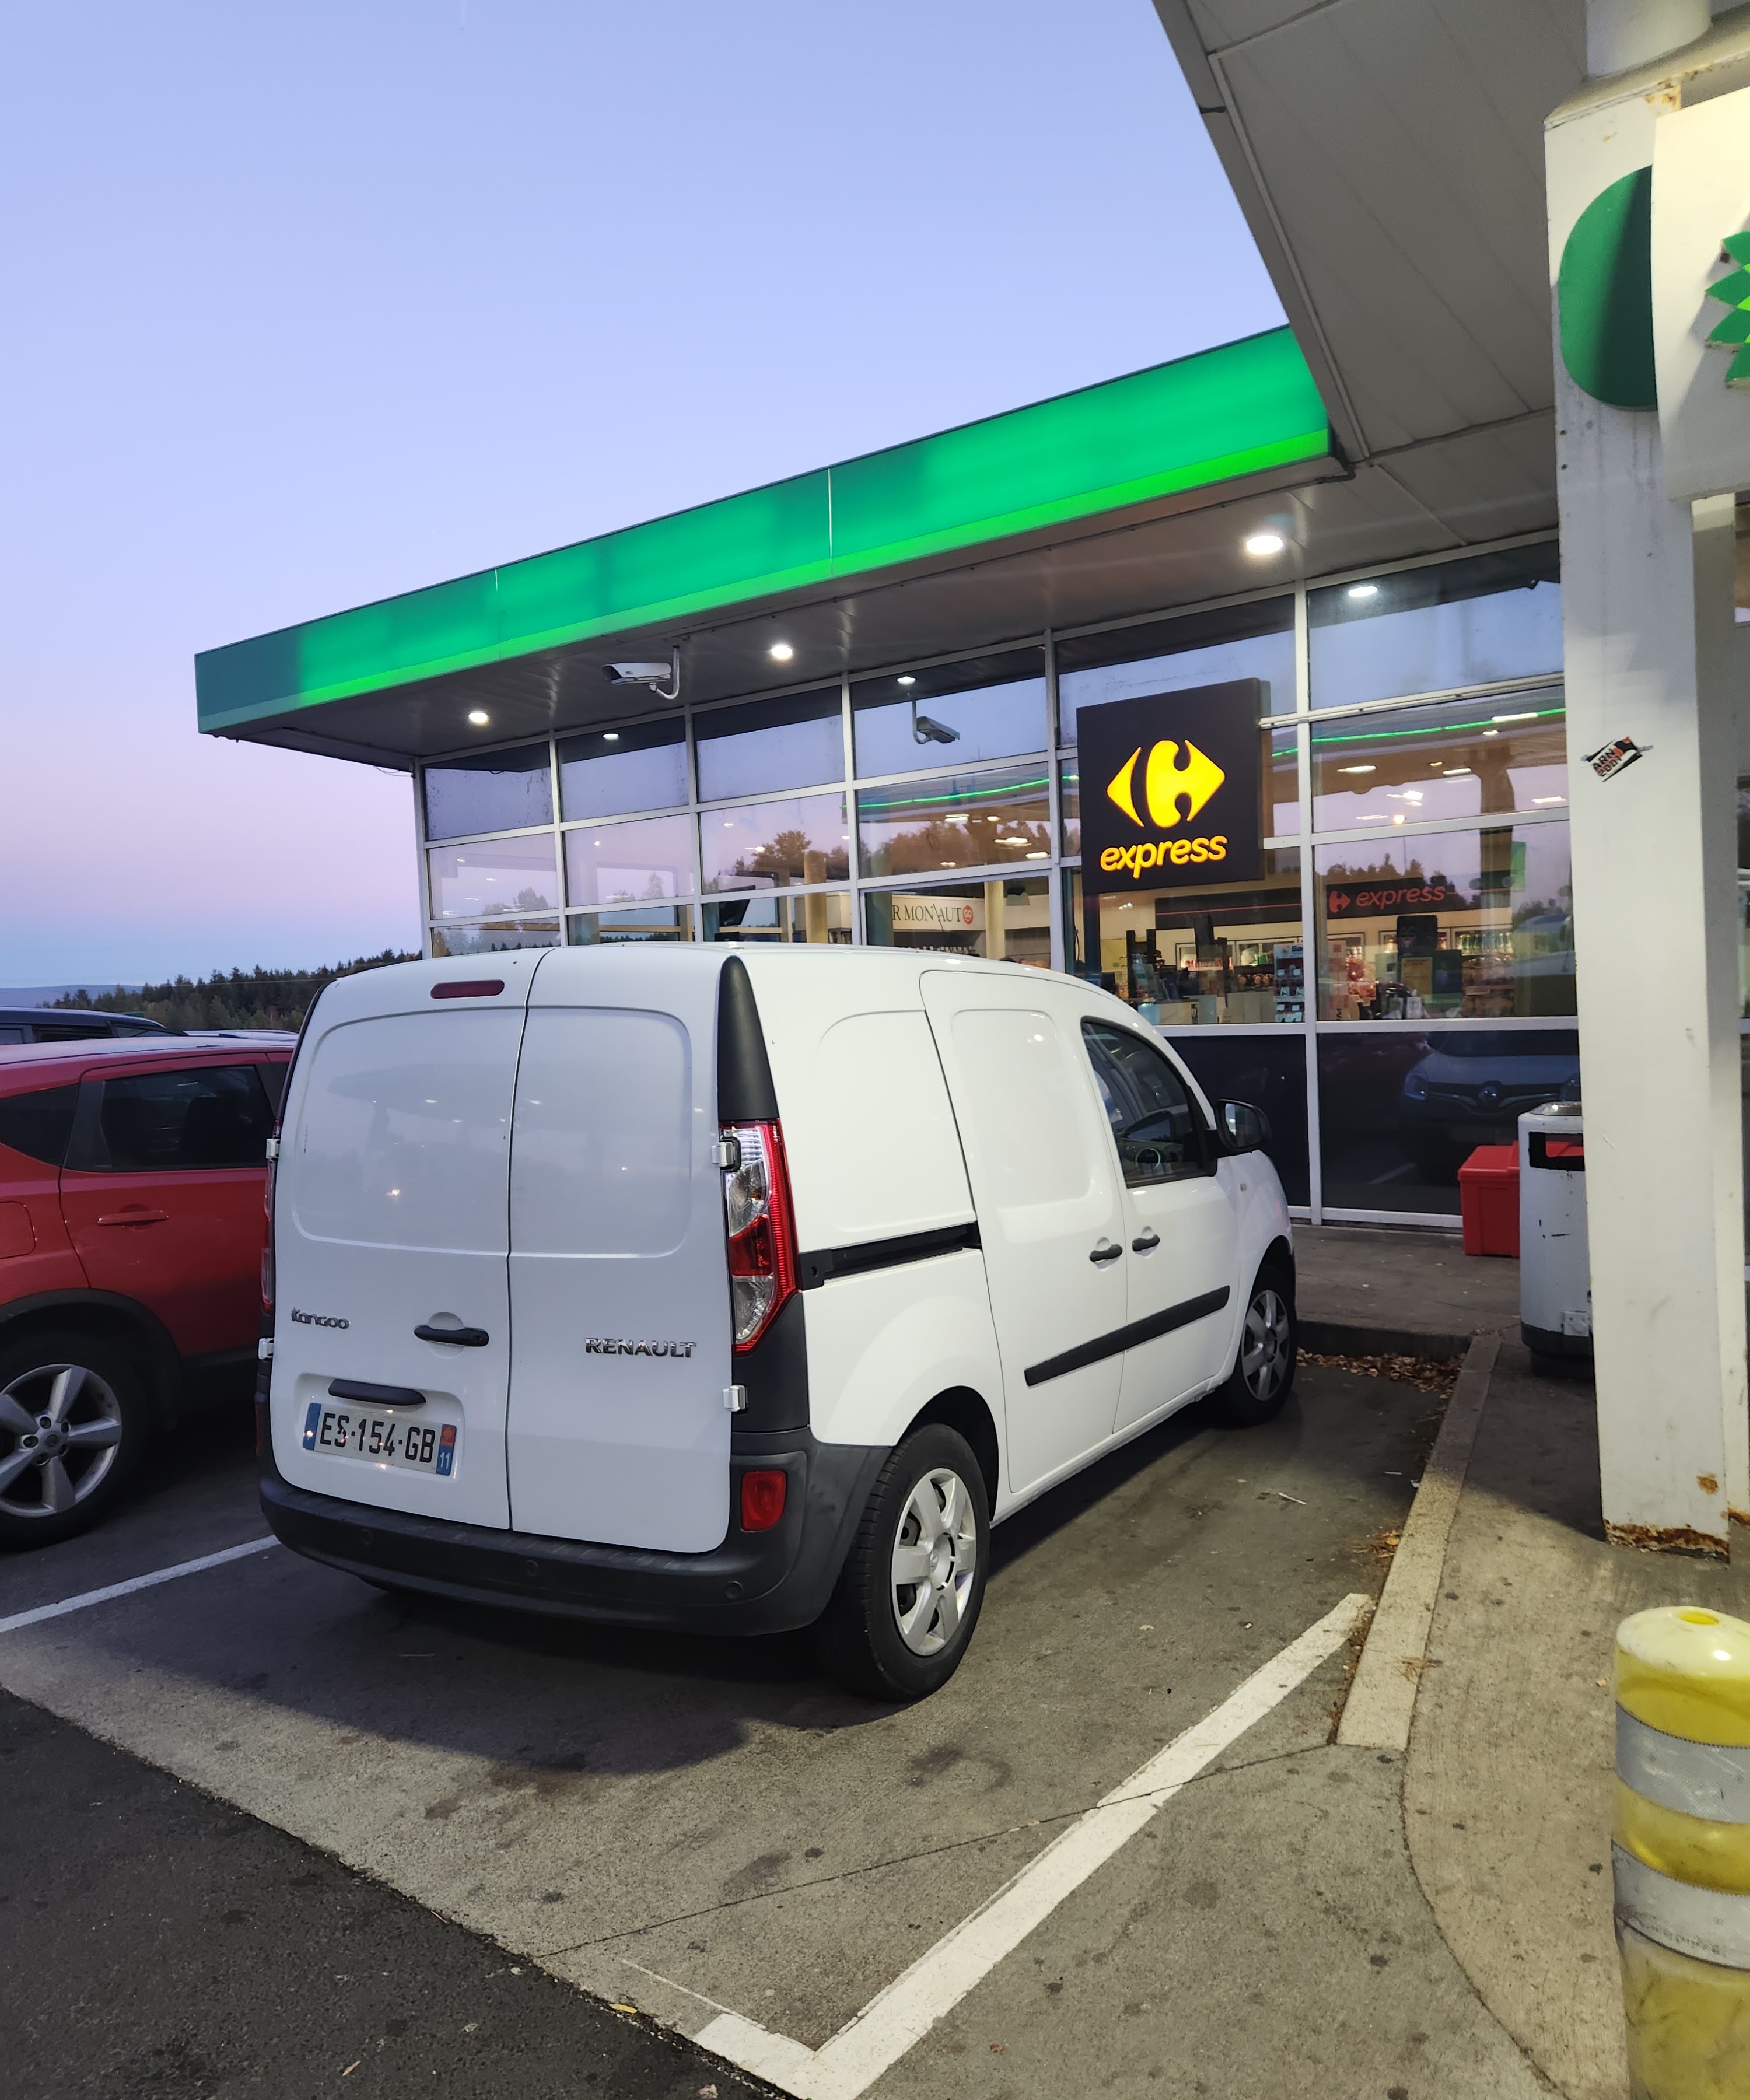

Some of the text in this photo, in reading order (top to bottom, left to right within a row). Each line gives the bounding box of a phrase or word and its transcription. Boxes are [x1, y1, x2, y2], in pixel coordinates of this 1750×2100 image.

[1100, 835, 1228, 878] express
[1356, 886, 1446, 909] express
[904, 905, 933, 922] MON
[585, 1337, 697, 1358] RENAULT
[440, 1452, 450, 1469] 11
